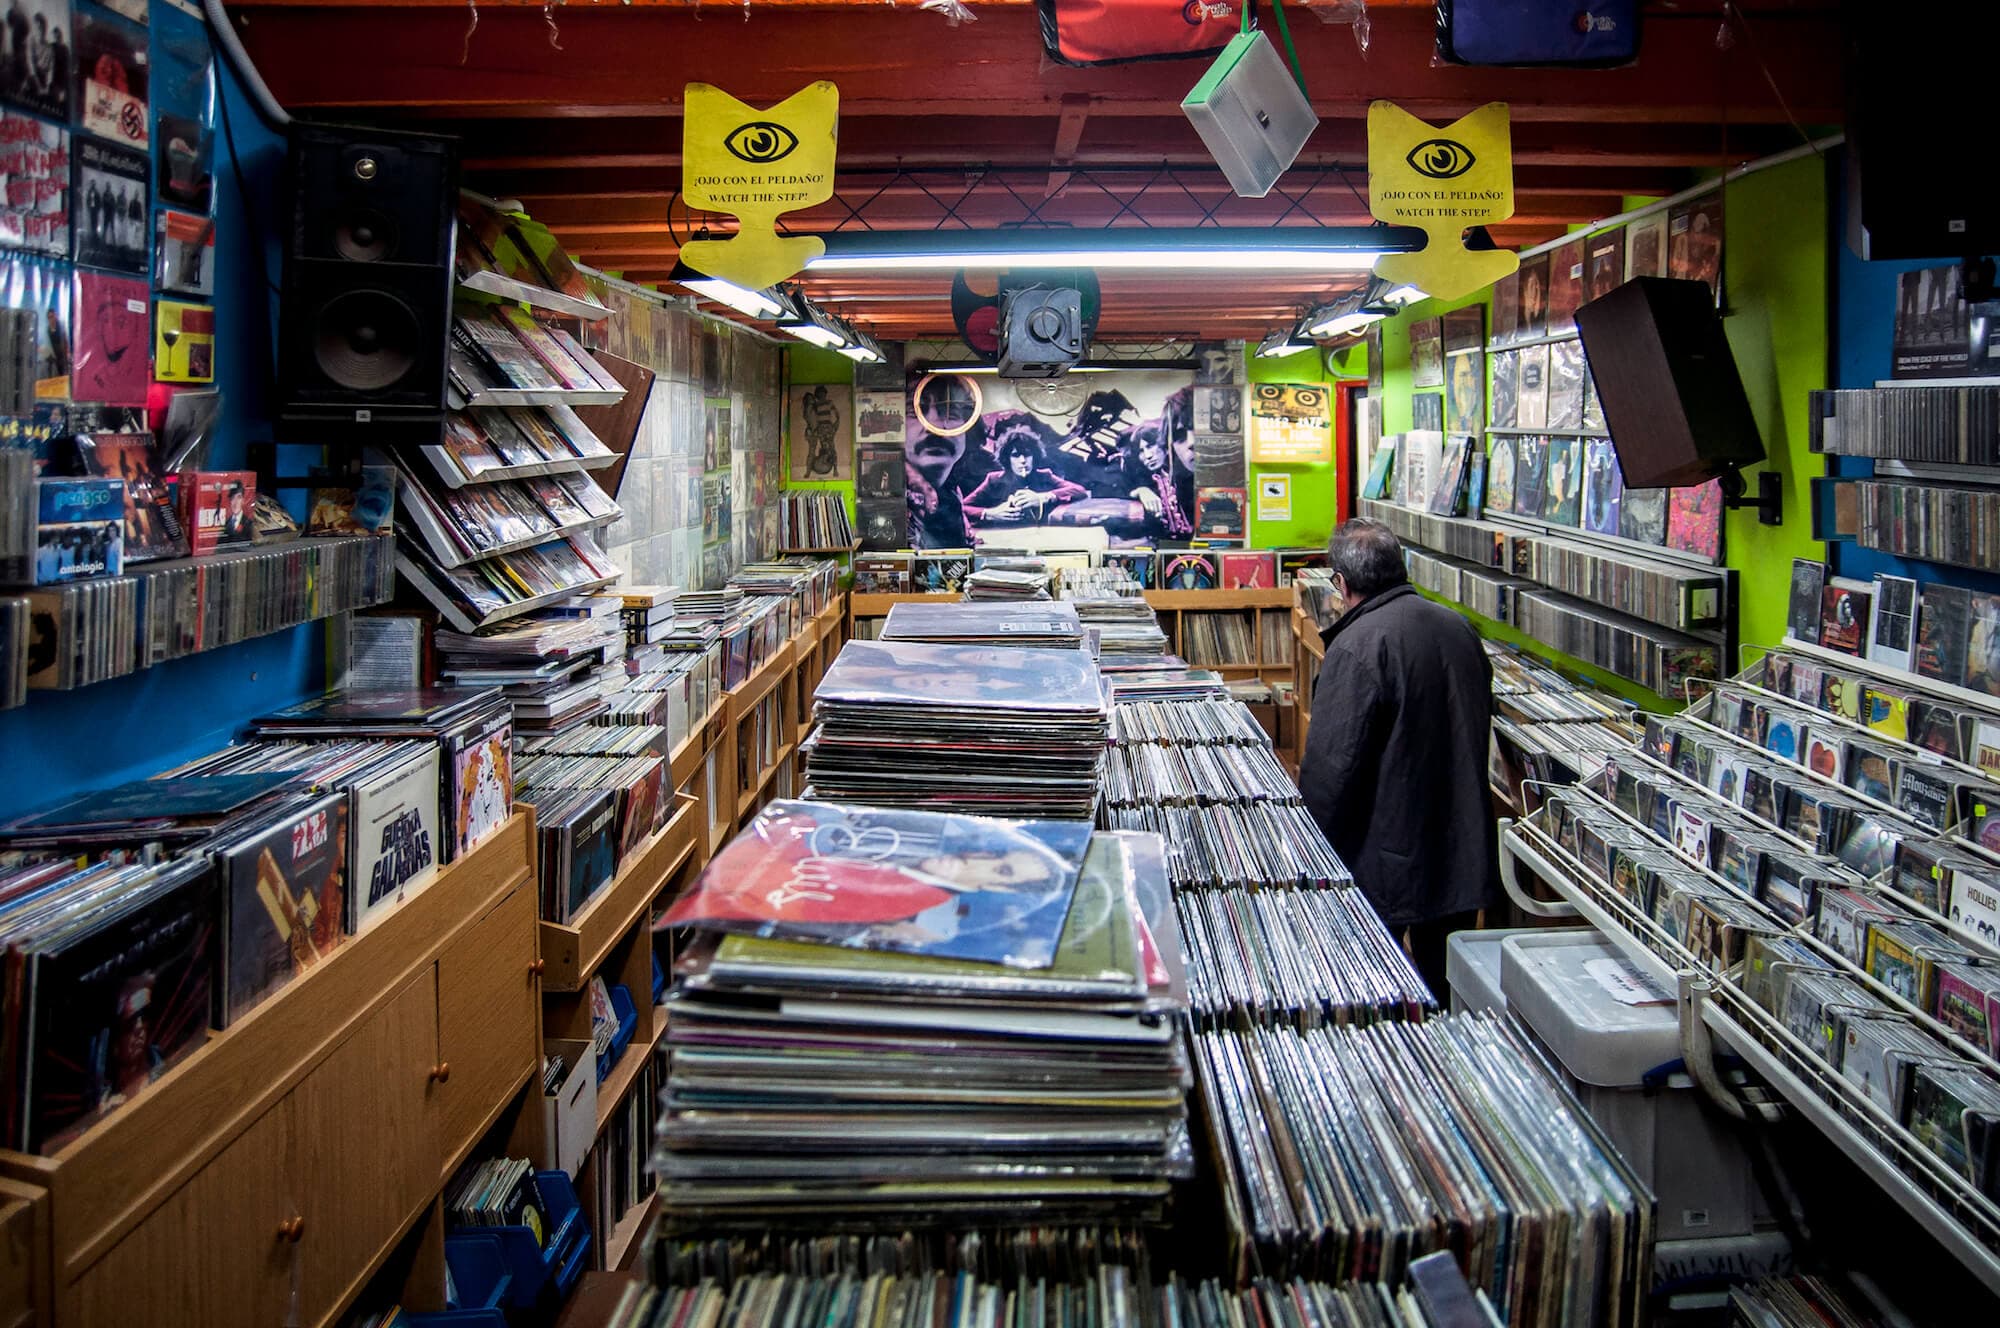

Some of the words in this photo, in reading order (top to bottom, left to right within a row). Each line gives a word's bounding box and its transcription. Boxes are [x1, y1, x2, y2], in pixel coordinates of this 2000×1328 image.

[693, 176, 721, 187] ¡OJO
[723, 176, 748, 185] CON
[750, 175, 765, 185] EL
[767, 173, 824, 185] PELDAÑO!
[708, 193, 749, 203] WATCH
[752, 193, 774, 202] THE
[777, 192, 808, 202] STEP!
[1381, 191, 1406, 201] ¡OJO
[1408, 191, 1432, 200] CON
[1434, 191, 1448, 200] EL
[1450, 189, 1504, 200] PELDAÑO!
[1395, 208, 1434, 217] WATCH
[1436, 208, 1459, 217] THE
[1461, 208, 1491, 217] STEP!
[59, 560, 105, 575] antologia
[1967, 885, 1997, 912] HOLLIES
